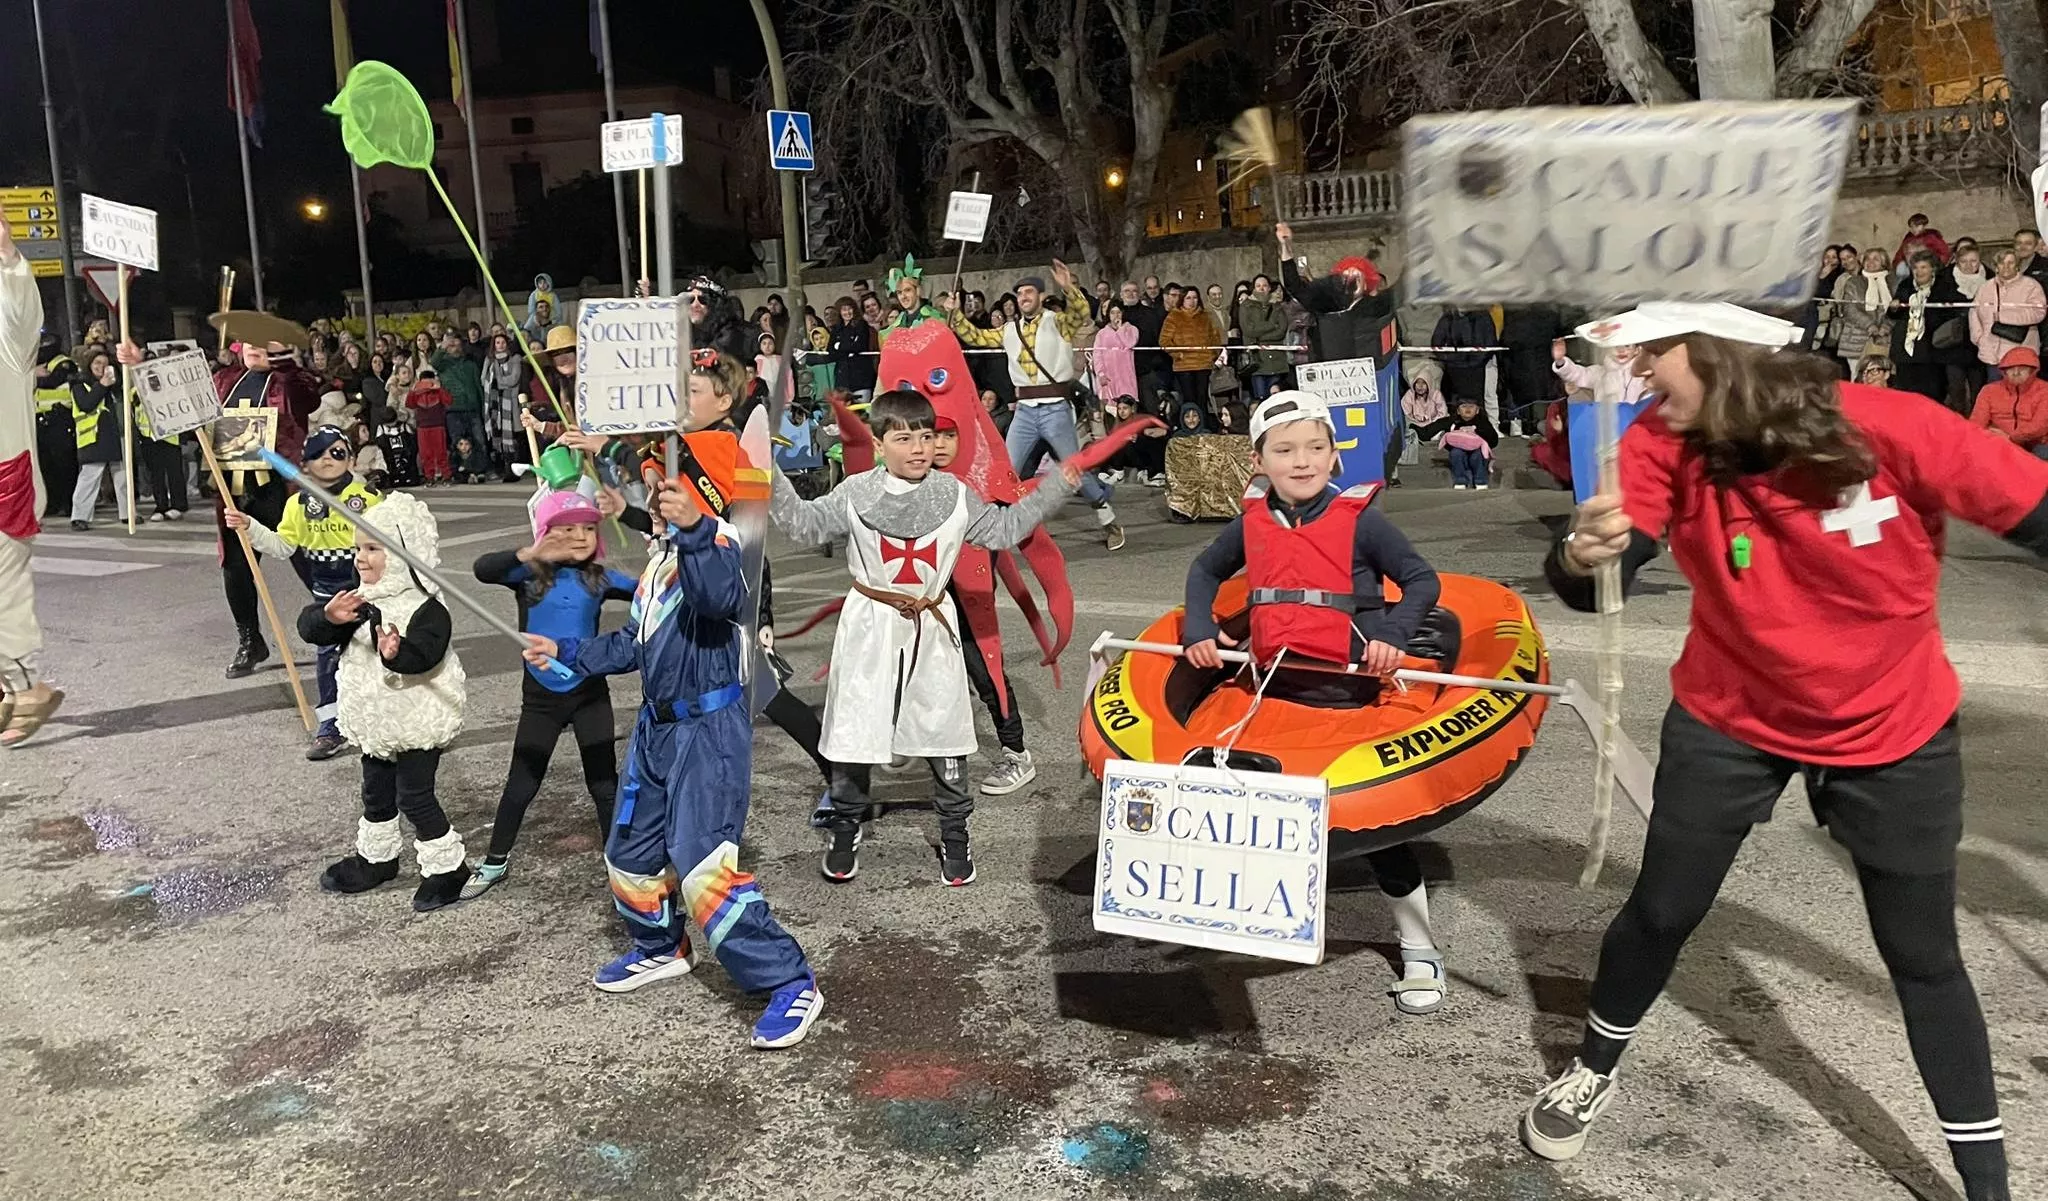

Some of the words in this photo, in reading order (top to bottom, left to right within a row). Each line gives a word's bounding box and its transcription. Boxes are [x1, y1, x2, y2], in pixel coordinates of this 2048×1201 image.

[1532, 148, 1803, 200] CALLE
[99, 212, 149, 234] AVENIDA
[93, 231, 145, 260] GOYA
[1459, 219, 1776, 277] SALOU
[167, 364, 204, 387] CALLE
[1320, 366, 1368, 381] PLAZA
[607, 384, 677, 412] ALLE
[1313, 384, 1371, 400] STACIÓN
[155, 392, 215, 422] SEGURA
[308, 523, 349, 533] POLICIA
[1100, 698, 1140, 731] PRO
[1374, 697, 1499, 768] EXPLORER
[1167, 806, 1300, 853] CALLE
[1126, 859, 1297, 919] SELLA
